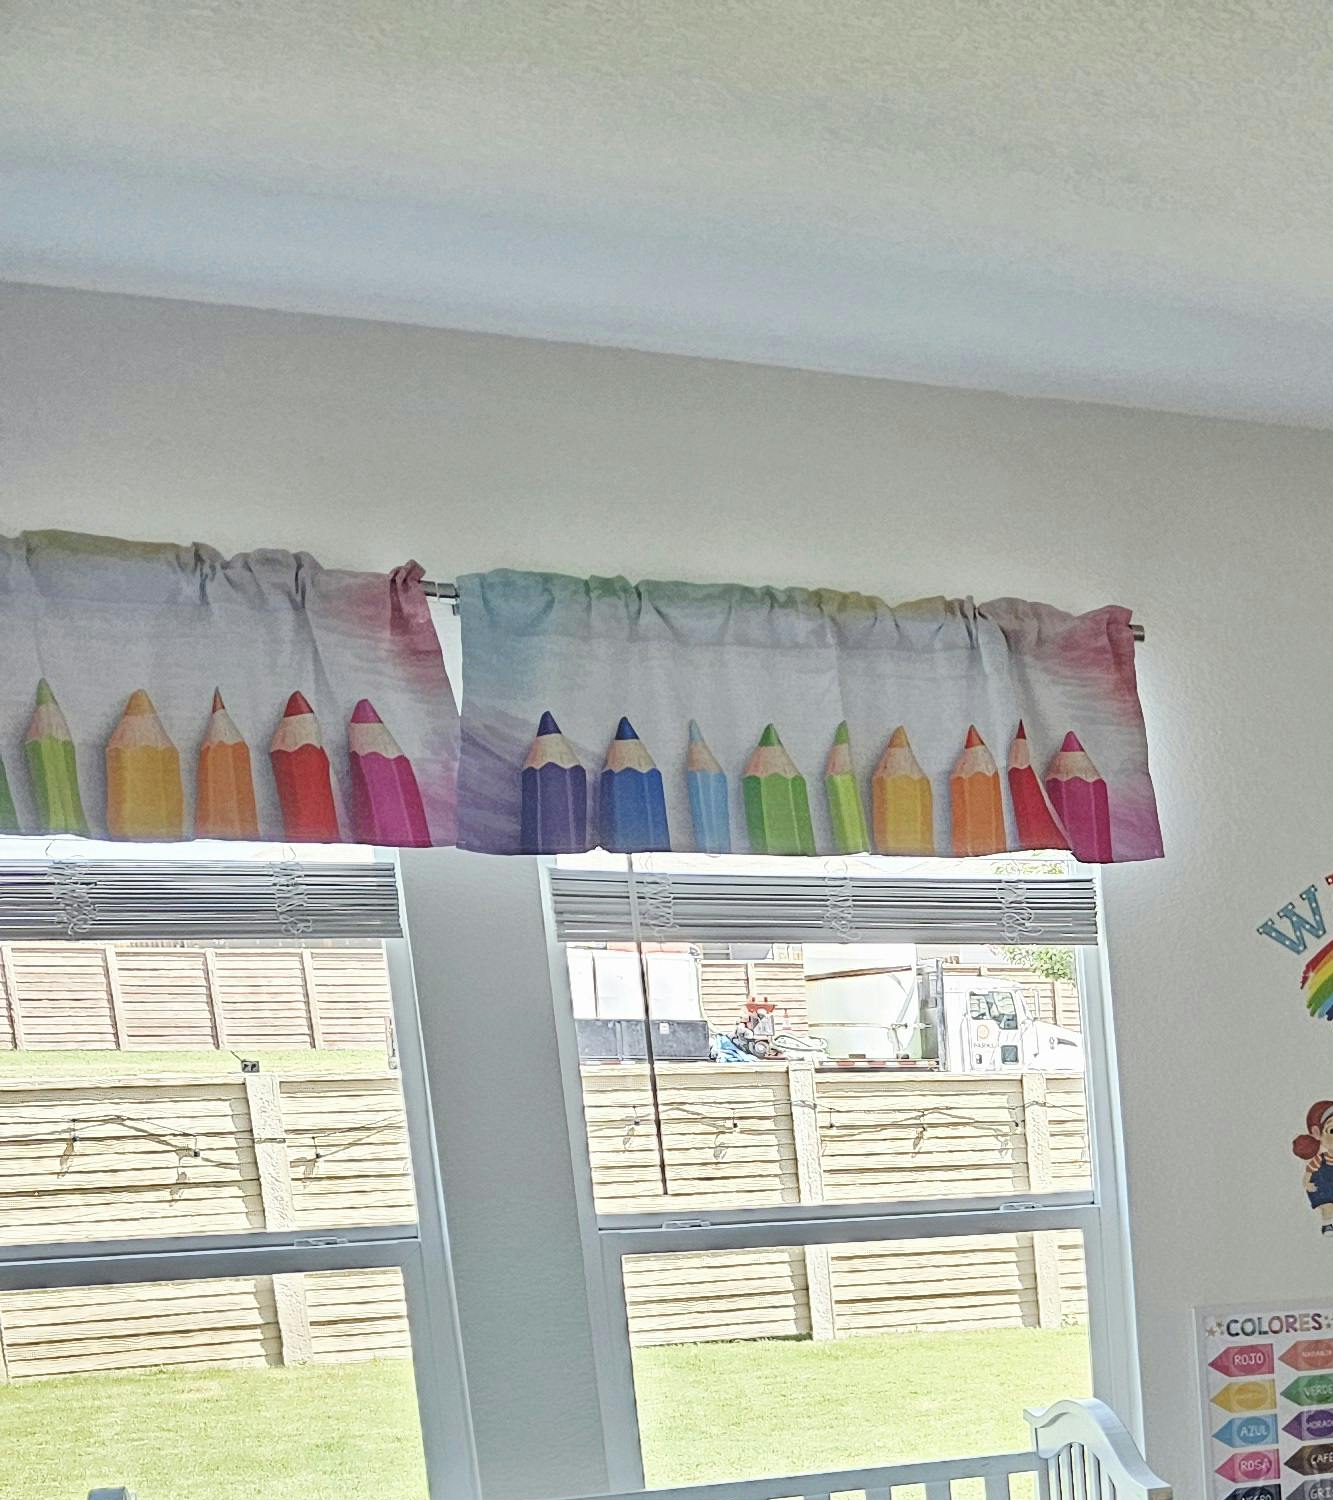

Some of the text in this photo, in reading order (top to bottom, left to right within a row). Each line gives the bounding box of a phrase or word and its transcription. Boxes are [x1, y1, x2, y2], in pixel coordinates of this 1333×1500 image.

[1225, 1312, 1324, 1337] COLORES
[1233, 1352, 1265, 1366] ROJO
[1240, 1424, 1268, 1437] AZUL
[1240, 1458, 1272, 1471] ROSA
